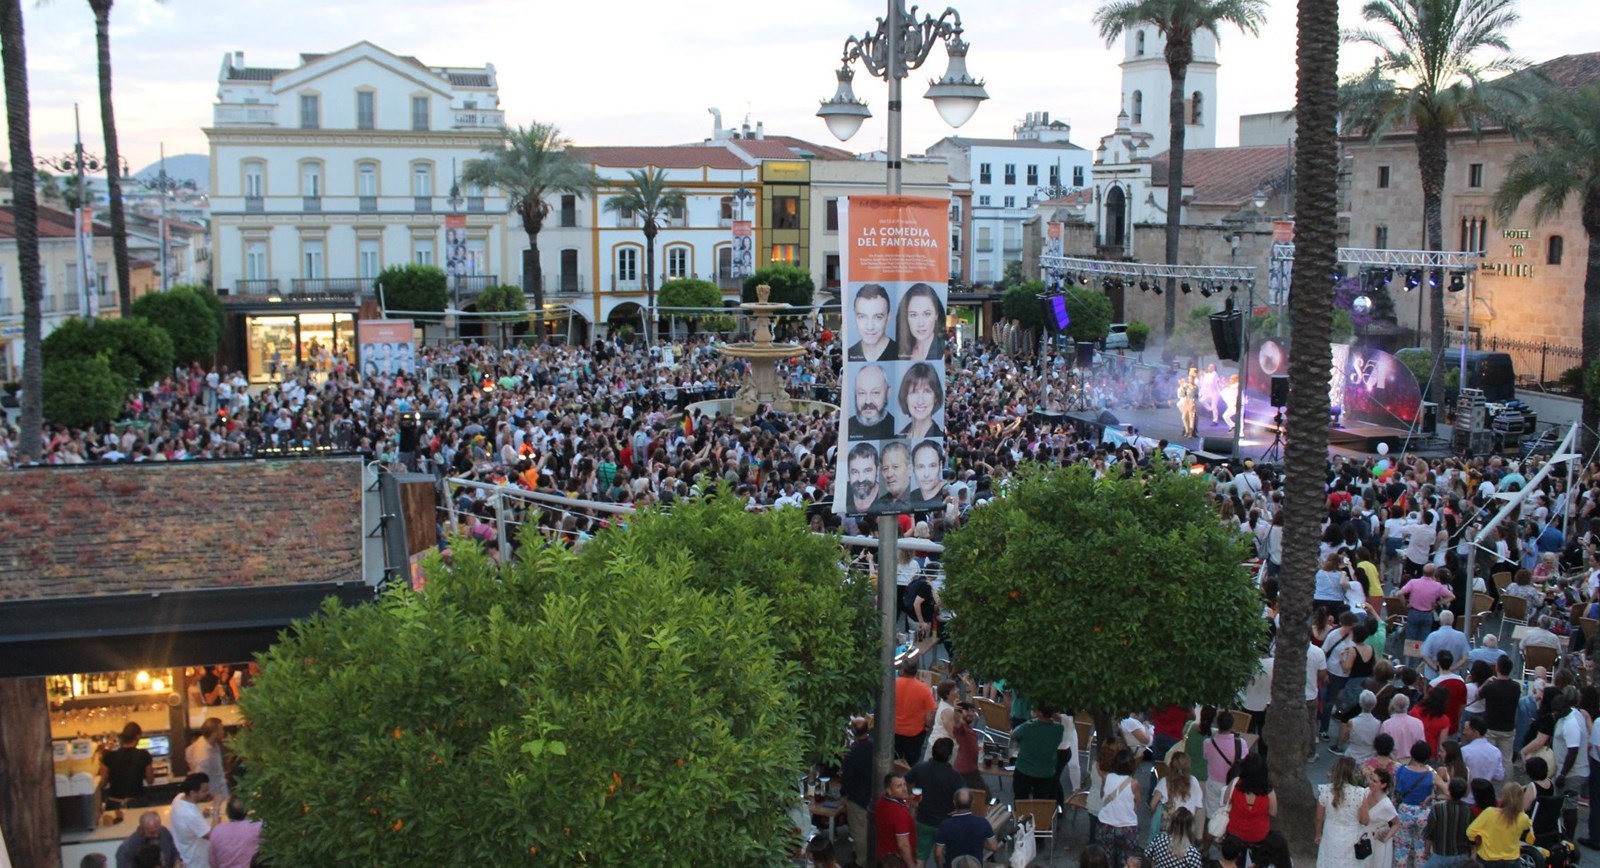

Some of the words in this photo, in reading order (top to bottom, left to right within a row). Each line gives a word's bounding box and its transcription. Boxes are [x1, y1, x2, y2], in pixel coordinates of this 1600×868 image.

[863, 227, 876, 236] LA
[879, 227, 930, 237] COMEDIA
[1503, 229, 1531, 240] HOTEL
[858, 238, 877, 247] DEL
[880, 238, 938, 248] FANTASMA
